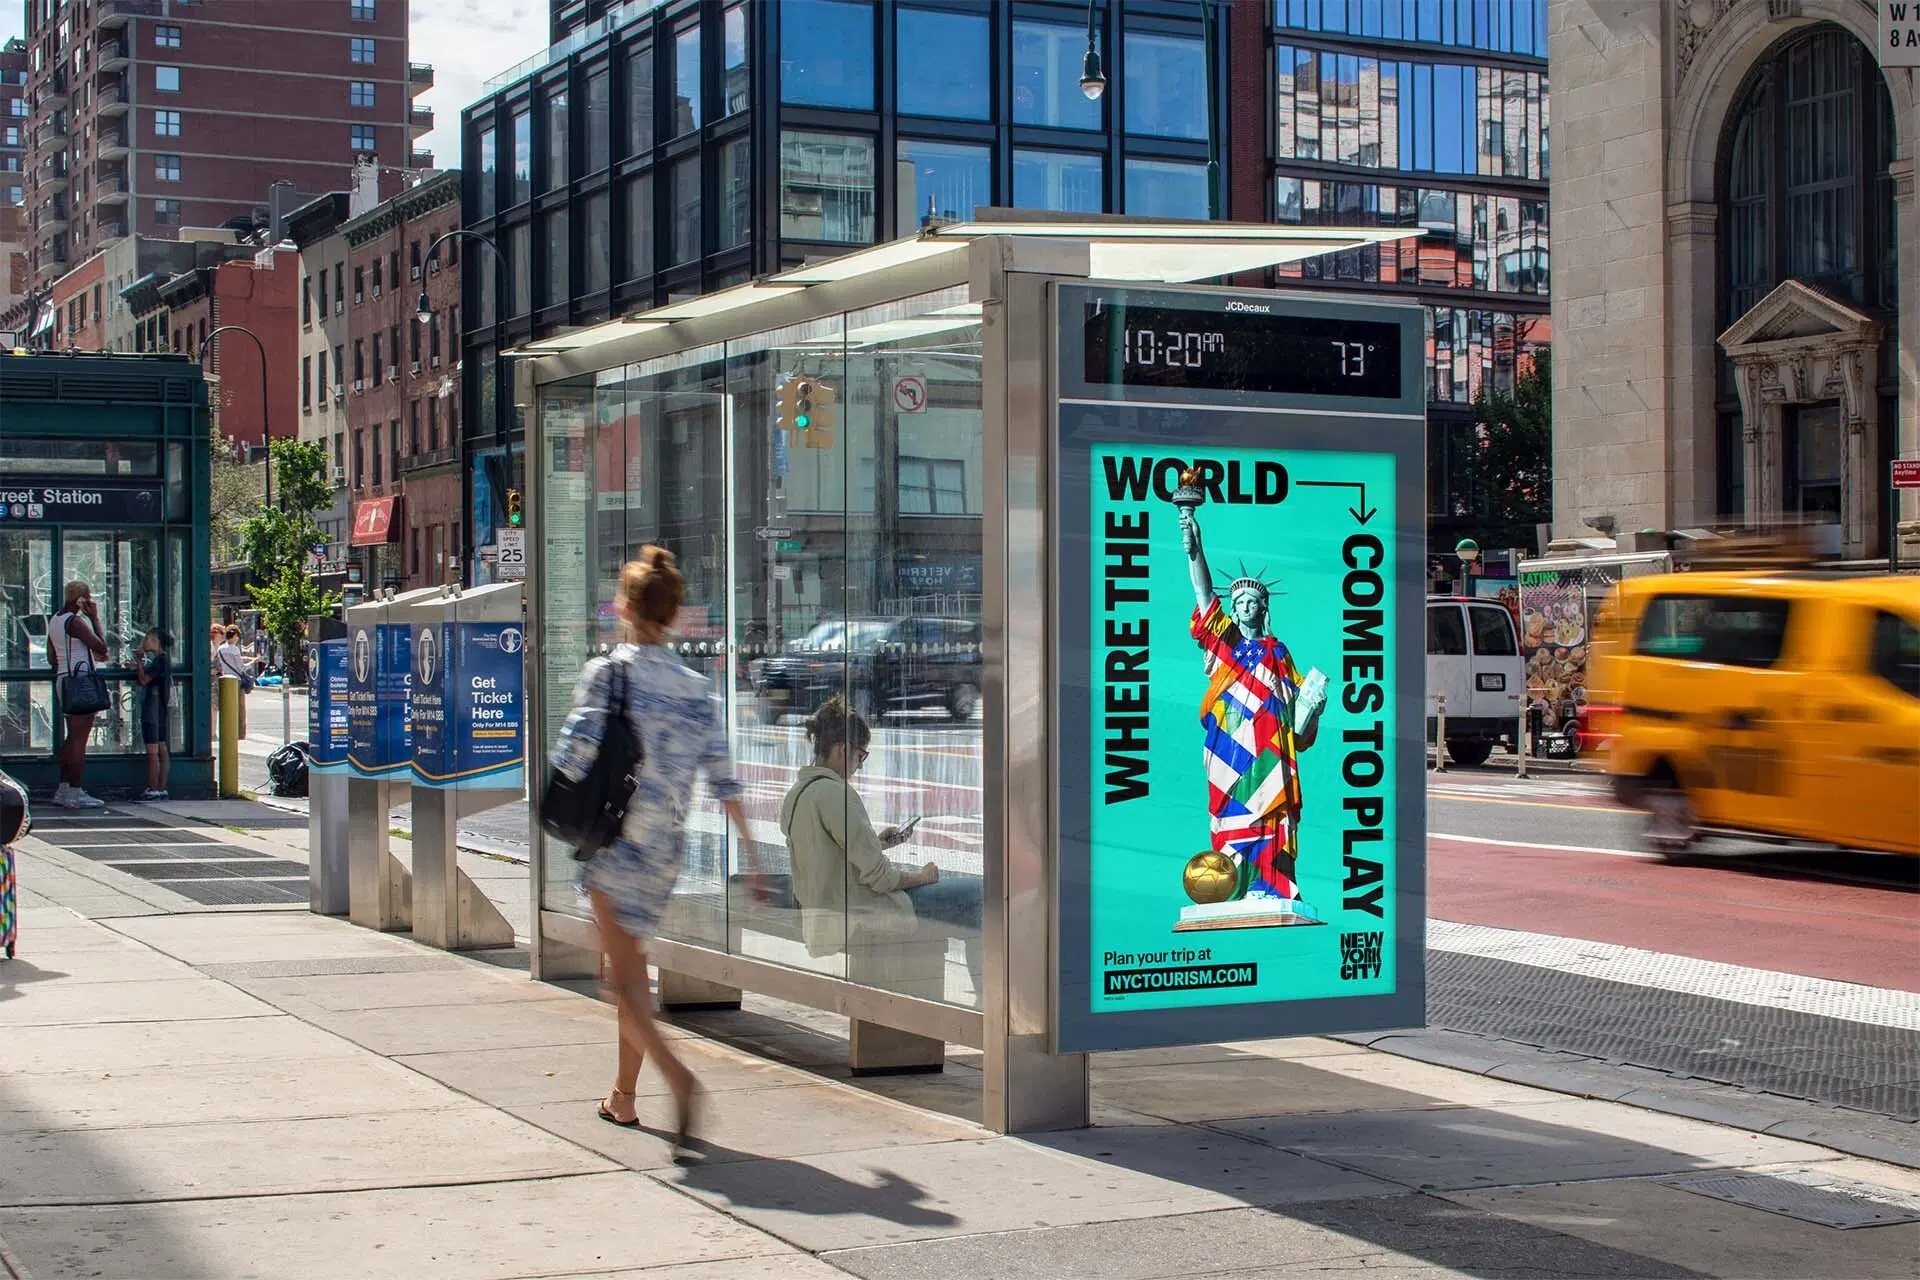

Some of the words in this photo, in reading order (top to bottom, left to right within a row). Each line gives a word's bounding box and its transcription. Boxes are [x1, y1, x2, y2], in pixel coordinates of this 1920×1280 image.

[1890, 3, 1907, 21] W
[1891, 29, 1900, 47] 8
[1225, 301, 1270, 313] JCDecaux
[1102, 455, 1289, 506] WORLD
[0, 489, 35, 503] reet
[43, 489, 102, 505] Station
[501, 549, 523, 562] 25
[1105, 511, 1149, 611] THE
[1342, 534, 1384, 714] COMES
[471, 676, 496, 689] Get
[471, 691, 513, 704] Ticket
[471, 706, 504, 720] Here
[1105, 619, 1149, 805] WHERE
[1342, 720, 1384, 789] TO
[1342, 796, 1384, 919] PLAY
[1340, 931, 1384, 949] NEW
[1104, 951, 1134, 966] Plan
[1137, 952, 1168, 967] your
[1171, 948, 1195, 964] trip
[1198, 948, 1212, 961] at
[1340, 947, 1382, 964] YORK
[1110, 967, 1252, 990] NYCTOURISM.COM
[1340, 963, 1382, 980] CITY
